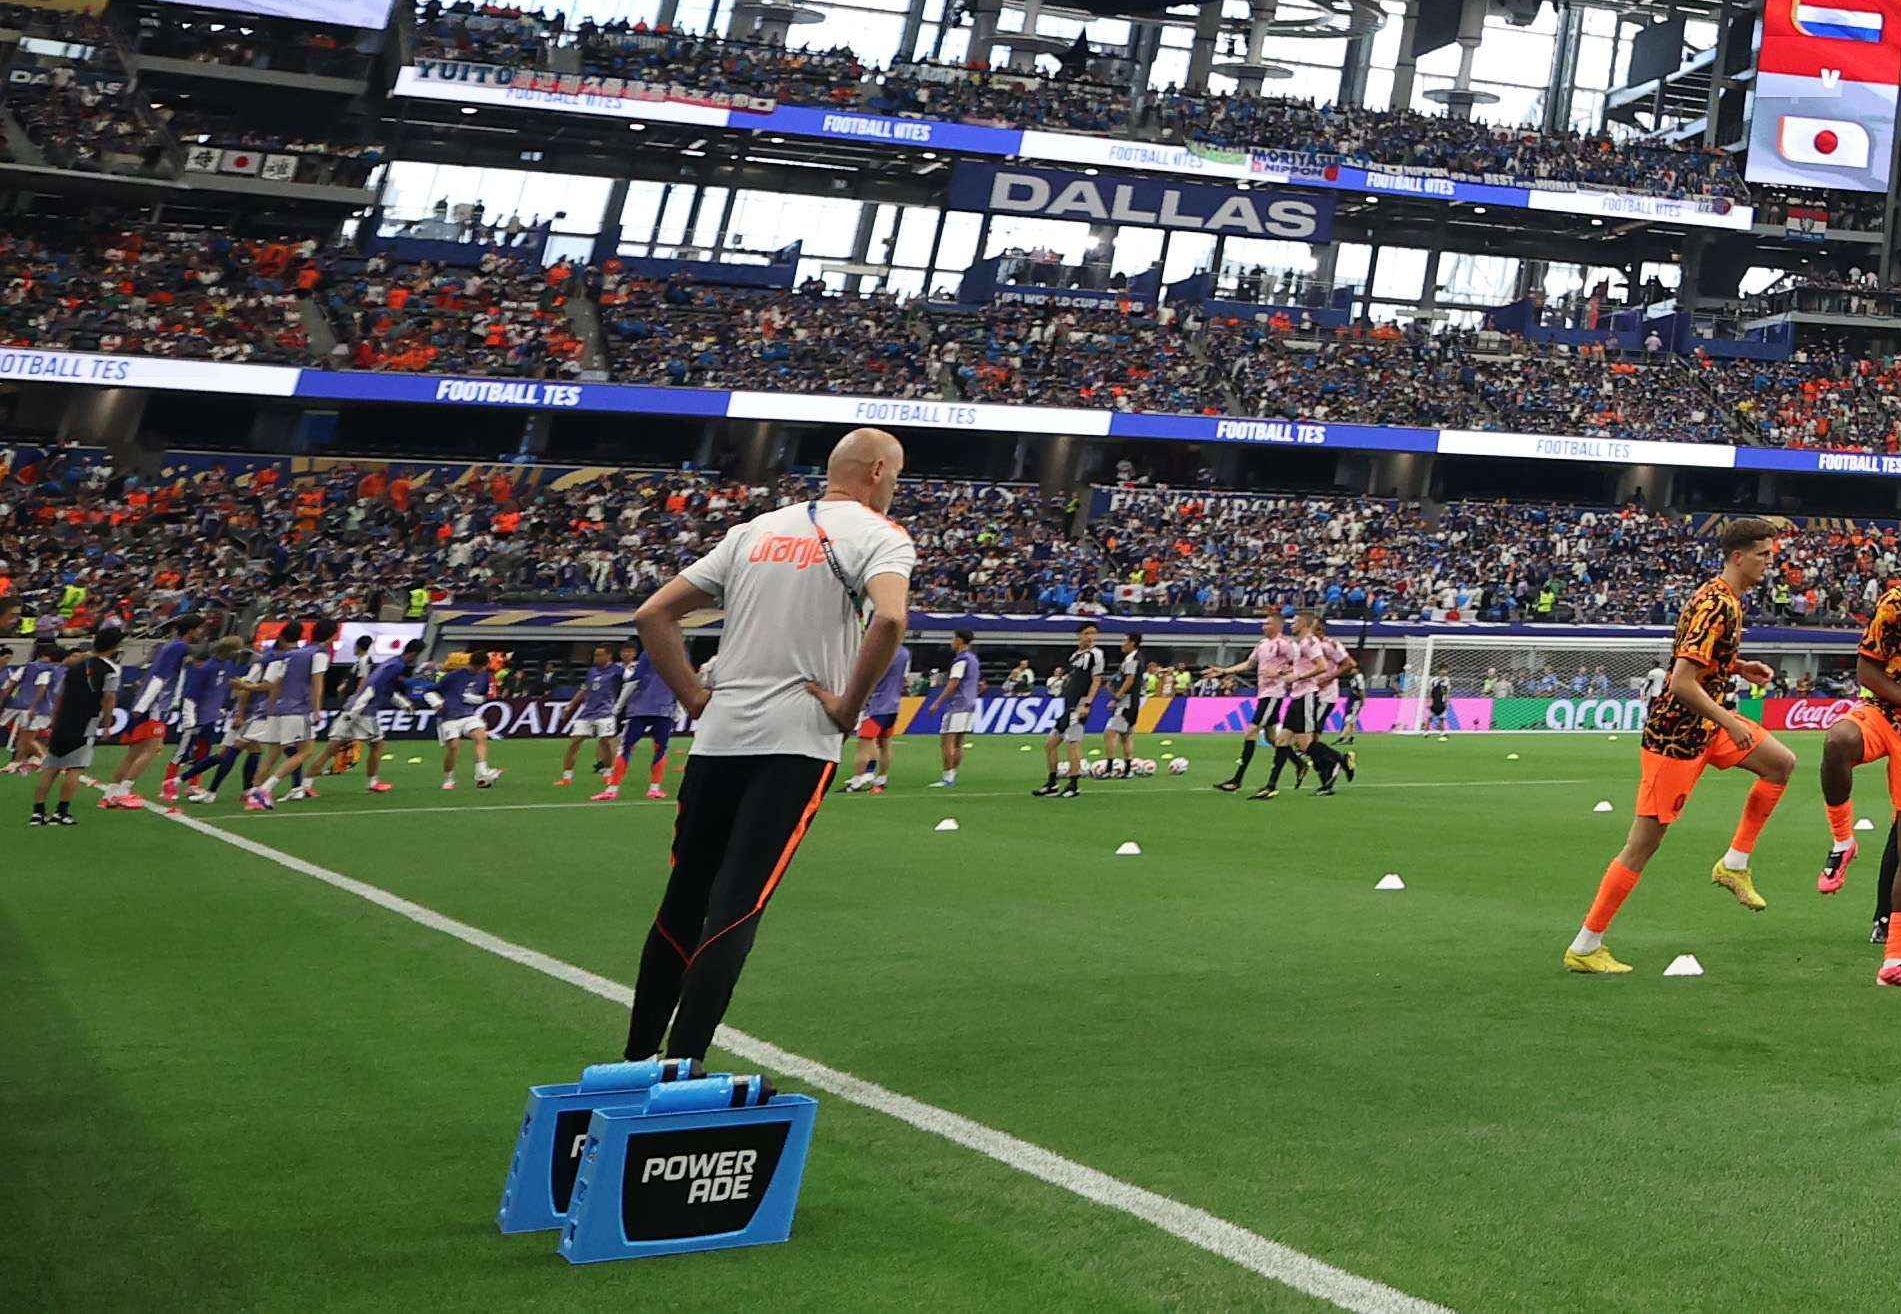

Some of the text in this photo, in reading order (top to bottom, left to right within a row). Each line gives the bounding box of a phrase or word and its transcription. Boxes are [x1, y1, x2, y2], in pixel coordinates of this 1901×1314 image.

[990, 172, 1318, 238] DALLAS
[0, 354, 81, 377] OTBALL
[974, 697, 1066, 734] VISA
[641, 1149, 757, 1183] POWER
[687, 1174, 753, 1204] ADE
